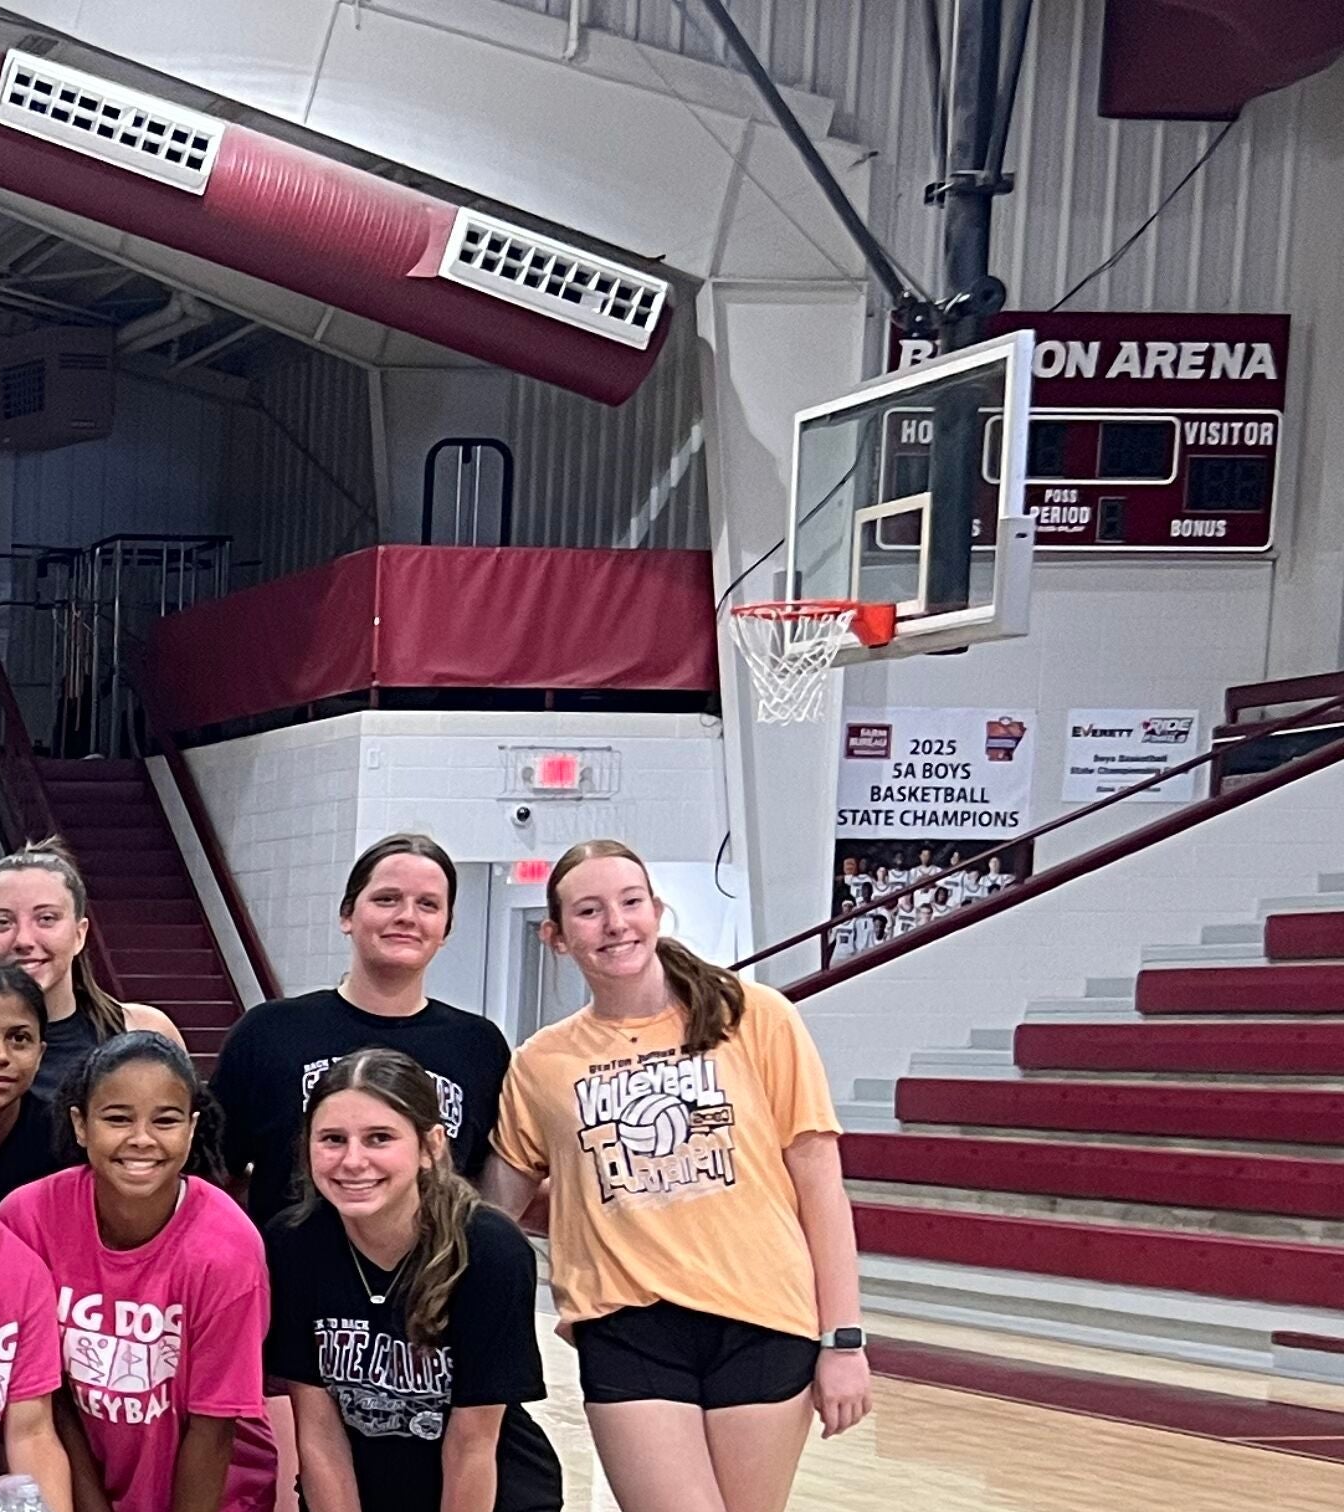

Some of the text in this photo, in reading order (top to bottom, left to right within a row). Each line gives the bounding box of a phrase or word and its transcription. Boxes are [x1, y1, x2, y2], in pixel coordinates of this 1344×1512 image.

[899, 339, 1278, 380] BON ARENA
[1184, 421, 1274, 446] VISITOR
[1044, 489, 1078, 504] POSS
[1030, 506, 1091, 524] PERIOD
[1170, 519, 1227, 537] BONUS
[909, 739, 957, 756] 2025
[892, 763, 971, 780] 5A BOYS
[870, 786, 990, 804] BASKETBALL
[837, 809, 1020, 828] STATE CHAMPIONS
[115, 1300, 183, 1343] DOG
